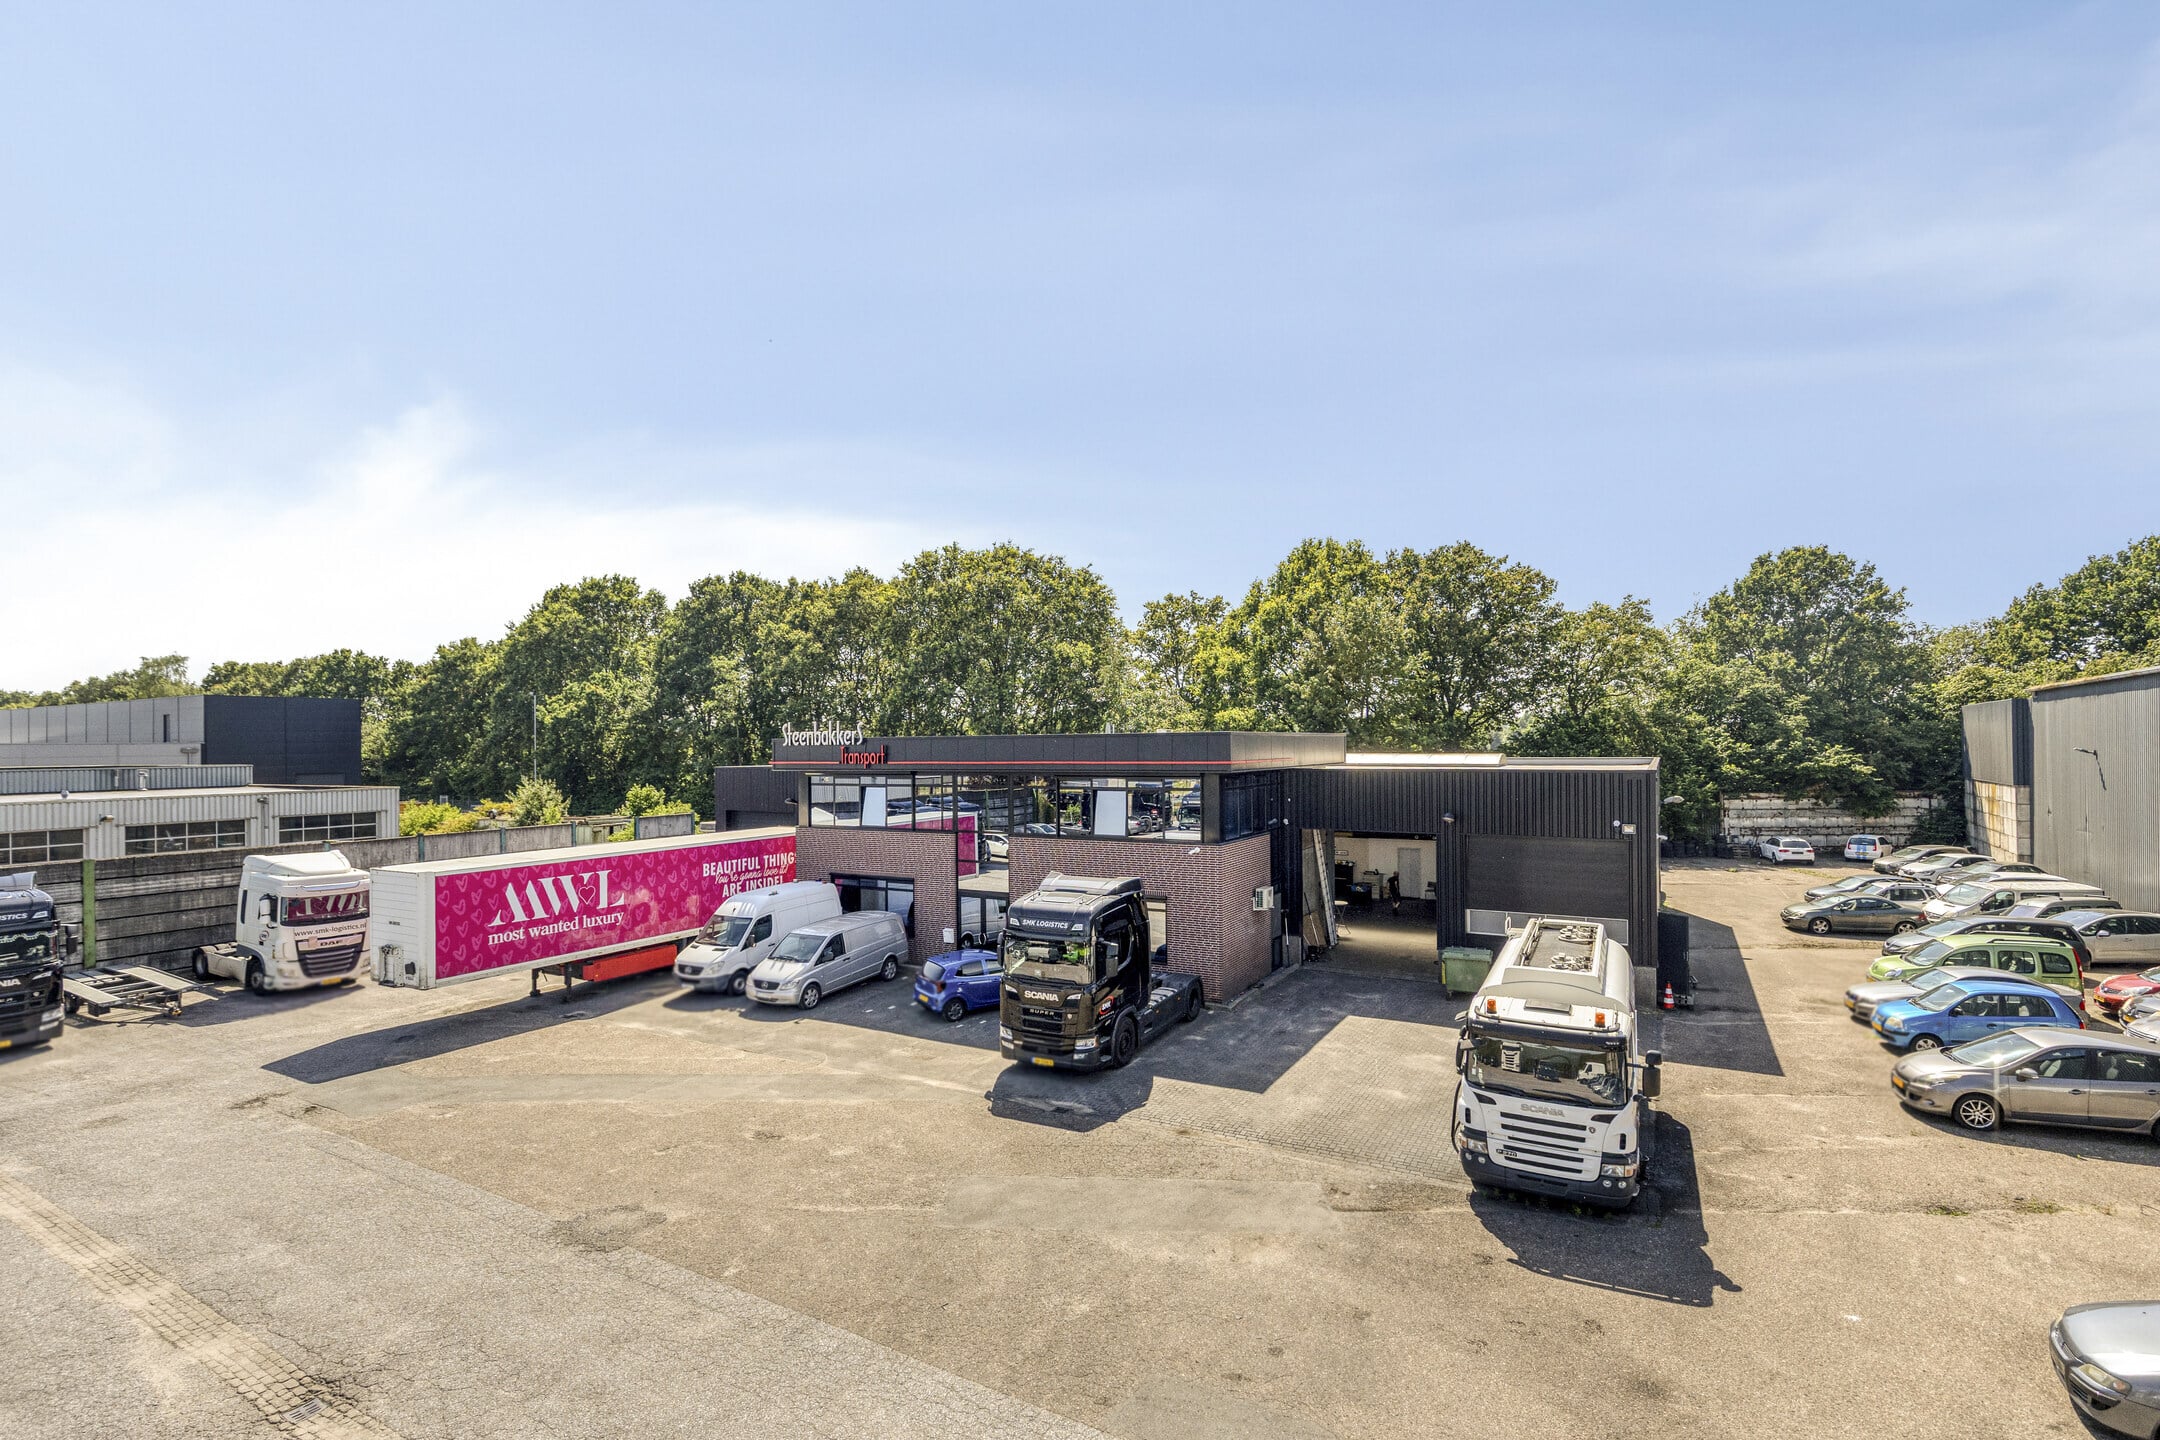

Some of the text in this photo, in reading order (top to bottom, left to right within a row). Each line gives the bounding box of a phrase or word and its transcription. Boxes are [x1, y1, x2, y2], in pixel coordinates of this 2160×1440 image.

[840, 745, 885, 769] Transport
[703, 856, 760, 877] BEAUTIFUL
[722, 882, 742, 898] ARE
[294, 922, 367, 937] www.smk-logistics.nl
[488, 912, 624, 945] most wanted luxury
[1036, 920, 1068, 929] LOGISTICS
[1024, 990, 1059, 1001] SCANIA
[1520, 1103, 1565, 1117] SCANIA
